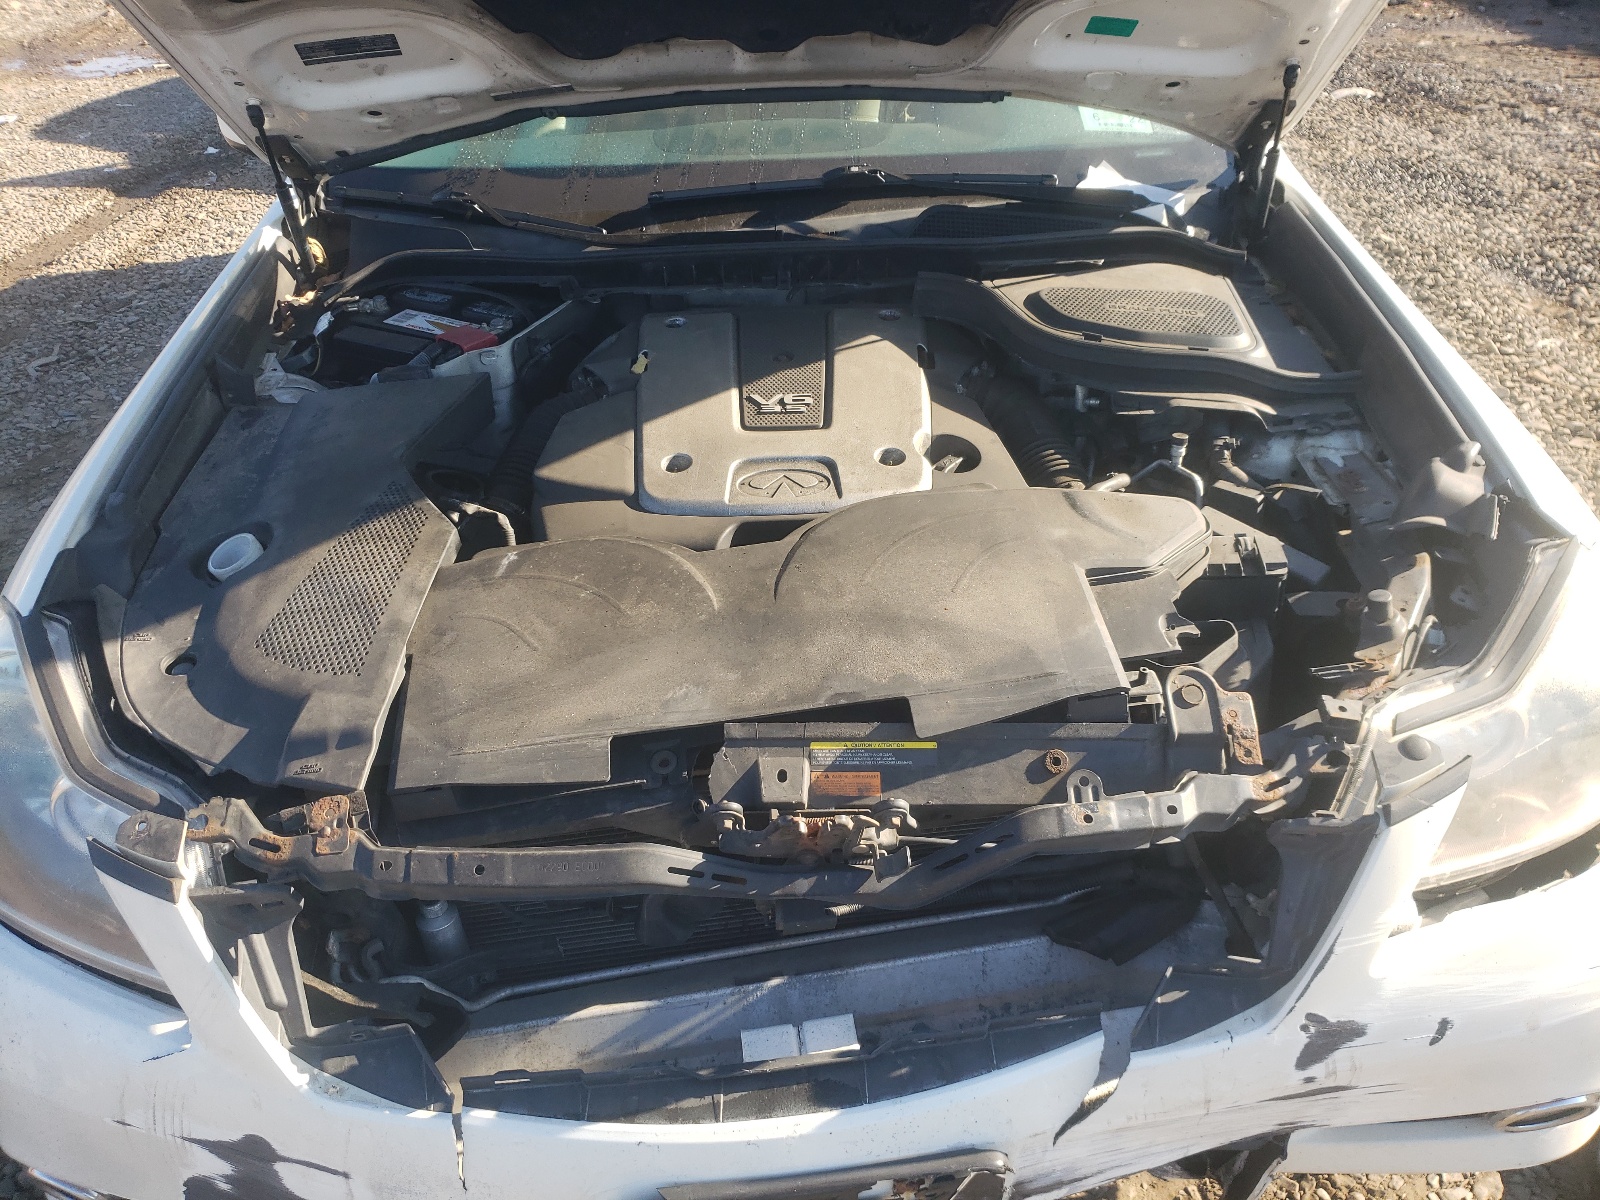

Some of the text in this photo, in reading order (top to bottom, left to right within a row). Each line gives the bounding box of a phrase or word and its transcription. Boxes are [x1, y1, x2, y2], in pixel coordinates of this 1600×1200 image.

[1108, 303, 1199, 316] BRAKE FLUID
[749, 393, 814, 405] V6
